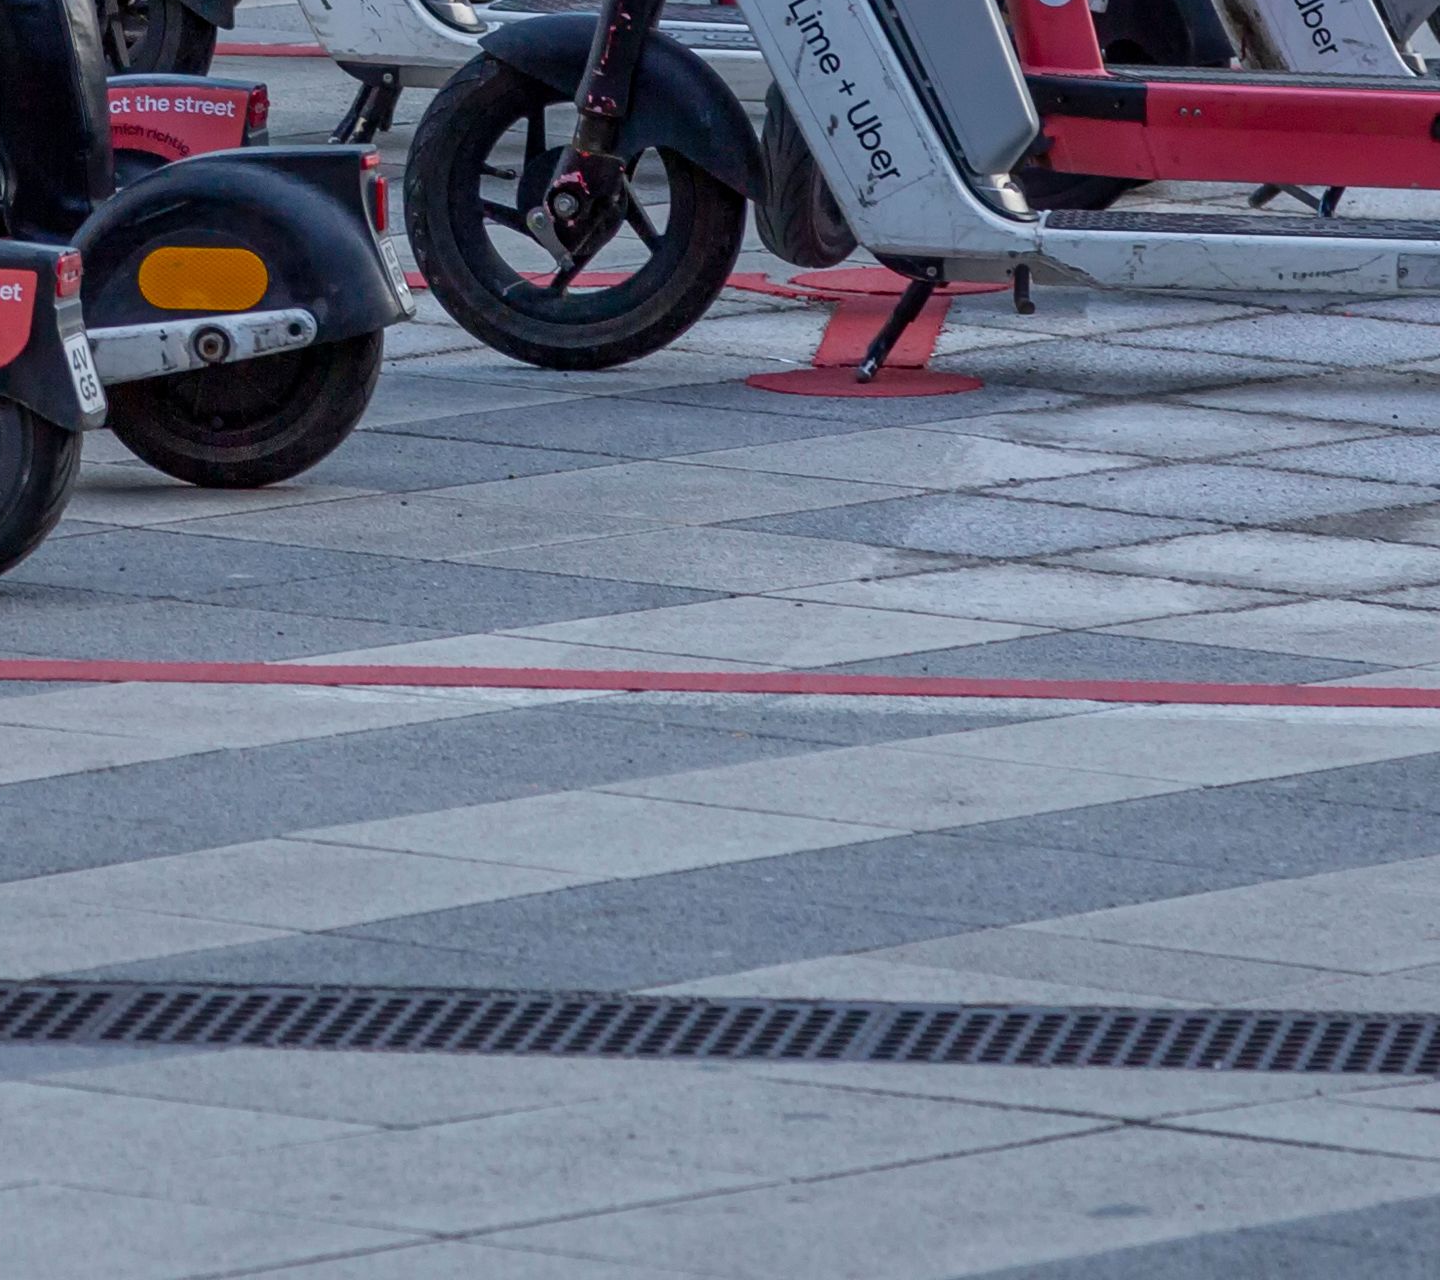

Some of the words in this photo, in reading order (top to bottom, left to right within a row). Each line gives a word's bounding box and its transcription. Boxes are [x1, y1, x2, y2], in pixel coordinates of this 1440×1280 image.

[135, 94, 171, 112] the
[174, 95, 236, 118] street
[146, 127, 191, 158] richtig
[838, 79, 856, 97] +
[847, 99, 902, 181] Uber
[71, 344, 89, 374] 4V
[79, 373, 99, 401] G5
